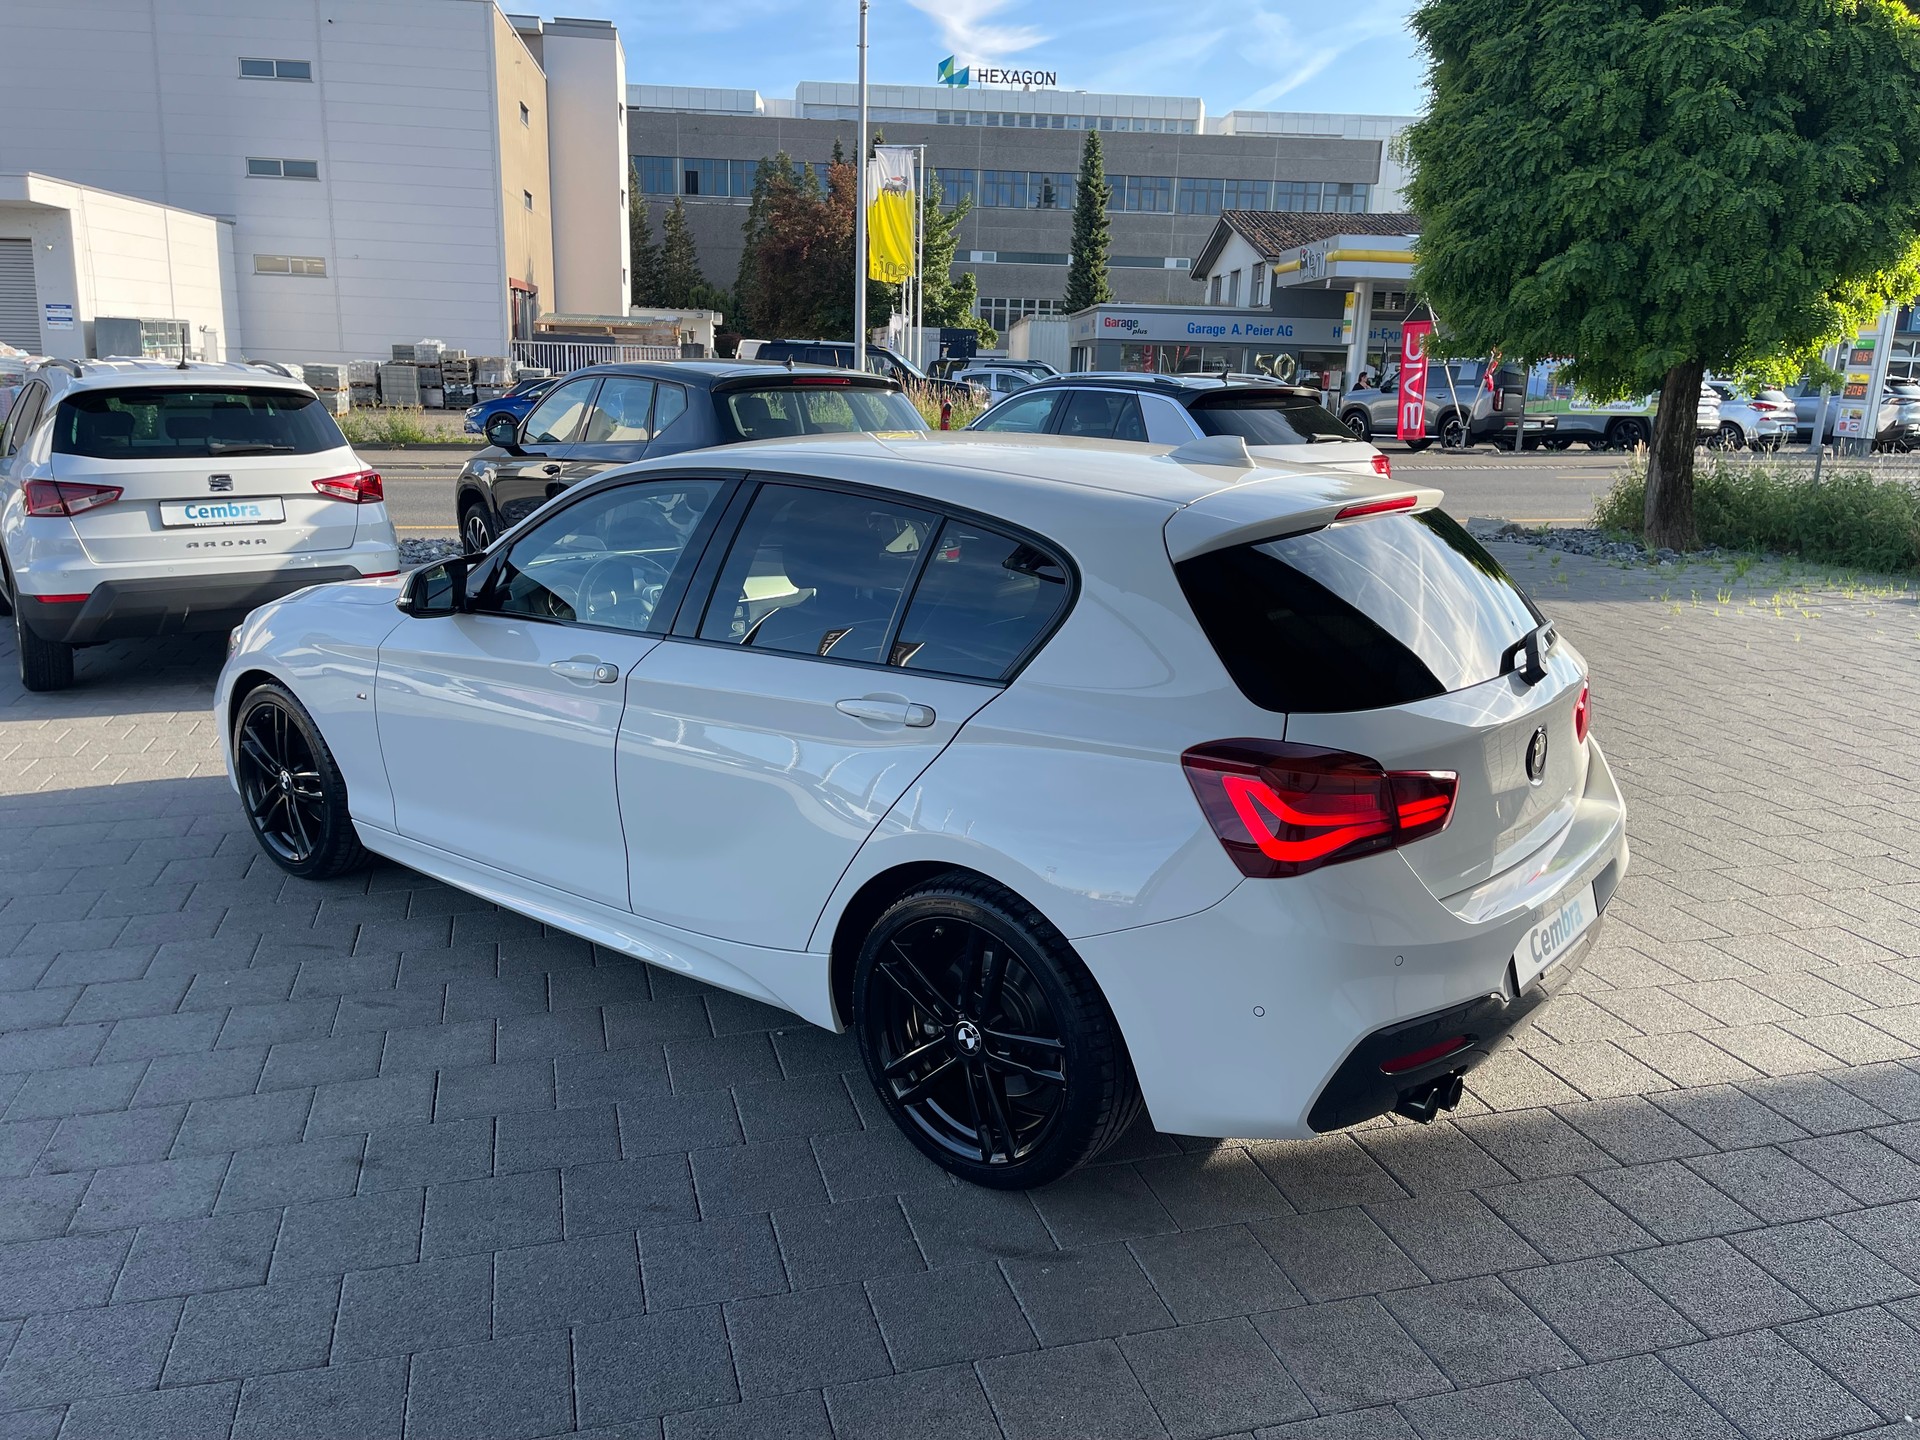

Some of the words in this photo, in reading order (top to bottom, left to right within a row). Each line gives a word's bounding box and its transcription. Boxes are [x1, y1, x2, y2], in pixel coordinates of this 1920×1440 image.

[978, 68, 1057, 86] HEXAGON
[1104, 317, 1139, 331] Garage
[1132, 328, 1148, 336] plus
[1187, 322, 1226, 337] Garage
[1231, 324, 1242, 336] A.
[1245, 324, 1275, 337] Peier
[1276, 325, 1293, 337] AG
[1403, 332, 1425, 430] BAIC
[184, 502, 262, 520] Cembra
[186, 538, 267, 549] ARONA
[1530, 900, 1583, 964] Cembra
